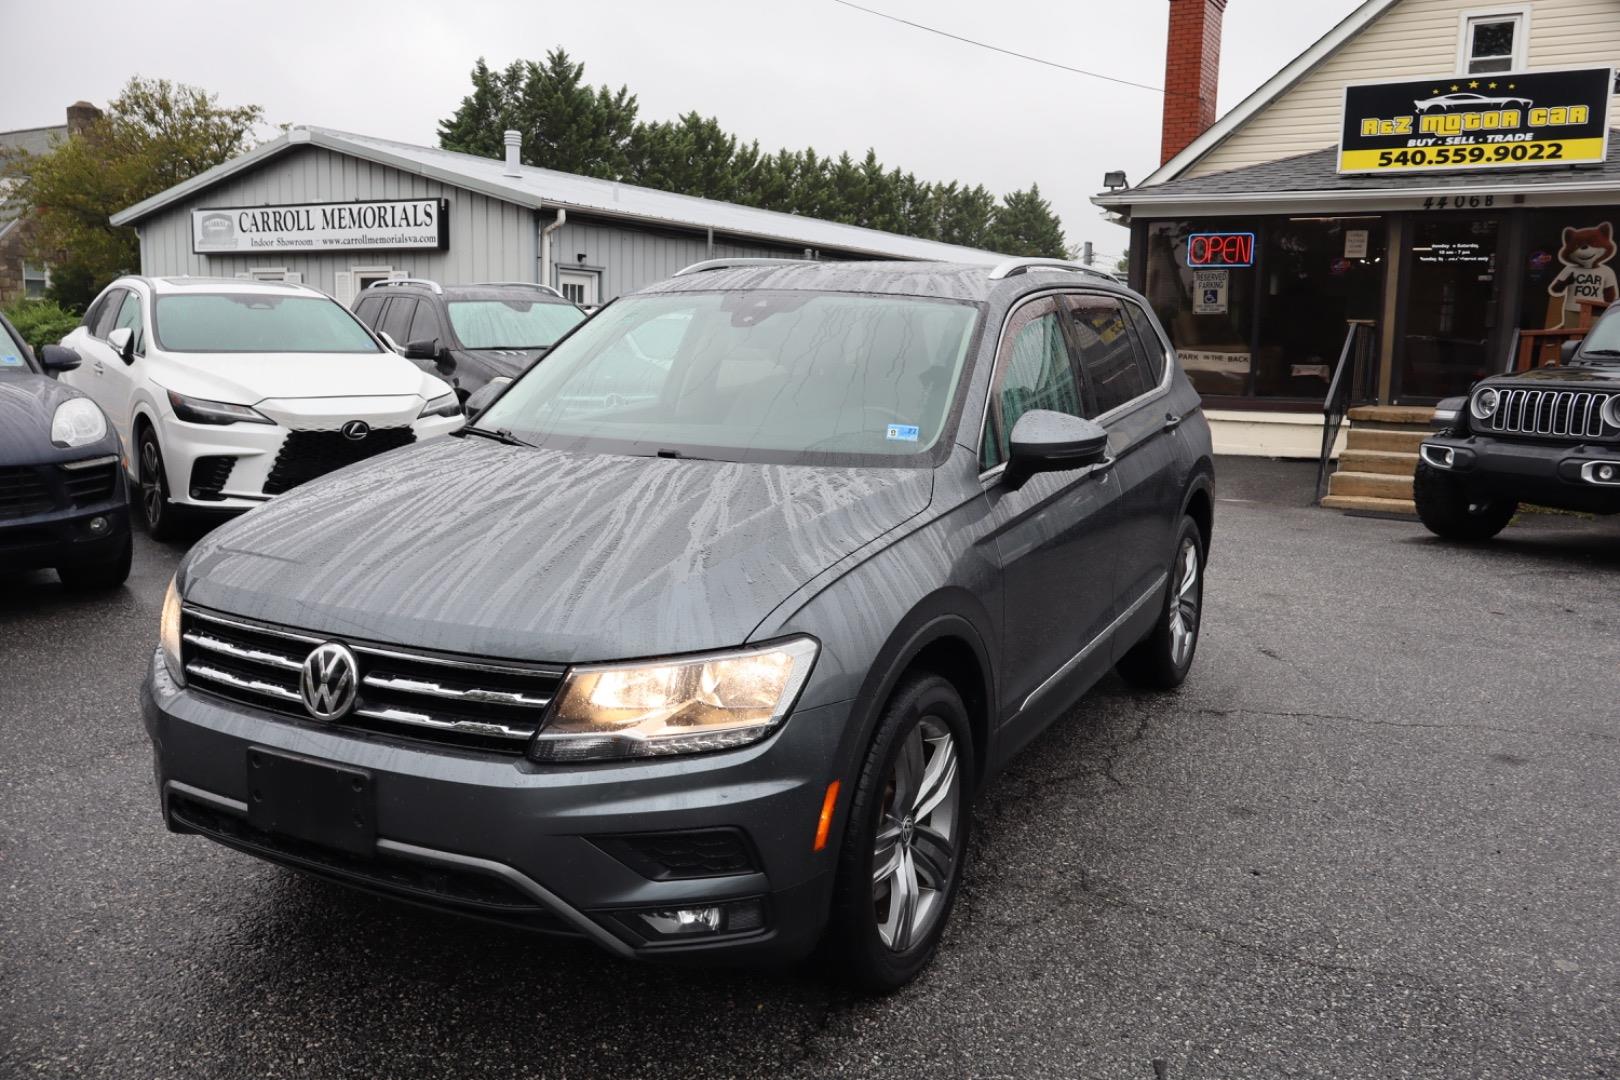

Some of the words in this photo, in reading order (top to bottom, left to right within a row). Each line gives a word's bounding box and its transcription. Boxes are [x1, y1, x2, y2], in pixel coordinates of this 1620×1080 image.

[1406, 137, 1437, 148] BUY
[1443, 135, 1476, 146] SELL
[1486, 132, 1534, 145] TRADE
[1377, 142, 1563, 168] 540.559.9022
[1423, 194, 1495, 210] 4406B
[238, 209, 315, 234] CARROLL
[321, 203, 434, 230] MEMORIALS
[250, 237, 275, 247] Indoor
[276, 236, 314, 247] Showroom
[322, 234, 437, 246] www.carrollmemorialsva.com
[1190, 236, 1252, 264] OPEN
[1196, 272, 1227, 281] RESERVED
[1576, 274, 1602, 285] CAR
[1198, 281, 1224, 289] PARKING
[1574, 286, 1600, 297] FOX
[1177, 352, 1199, 361] PARK
[1227, 355, 1249, 363] BACK
